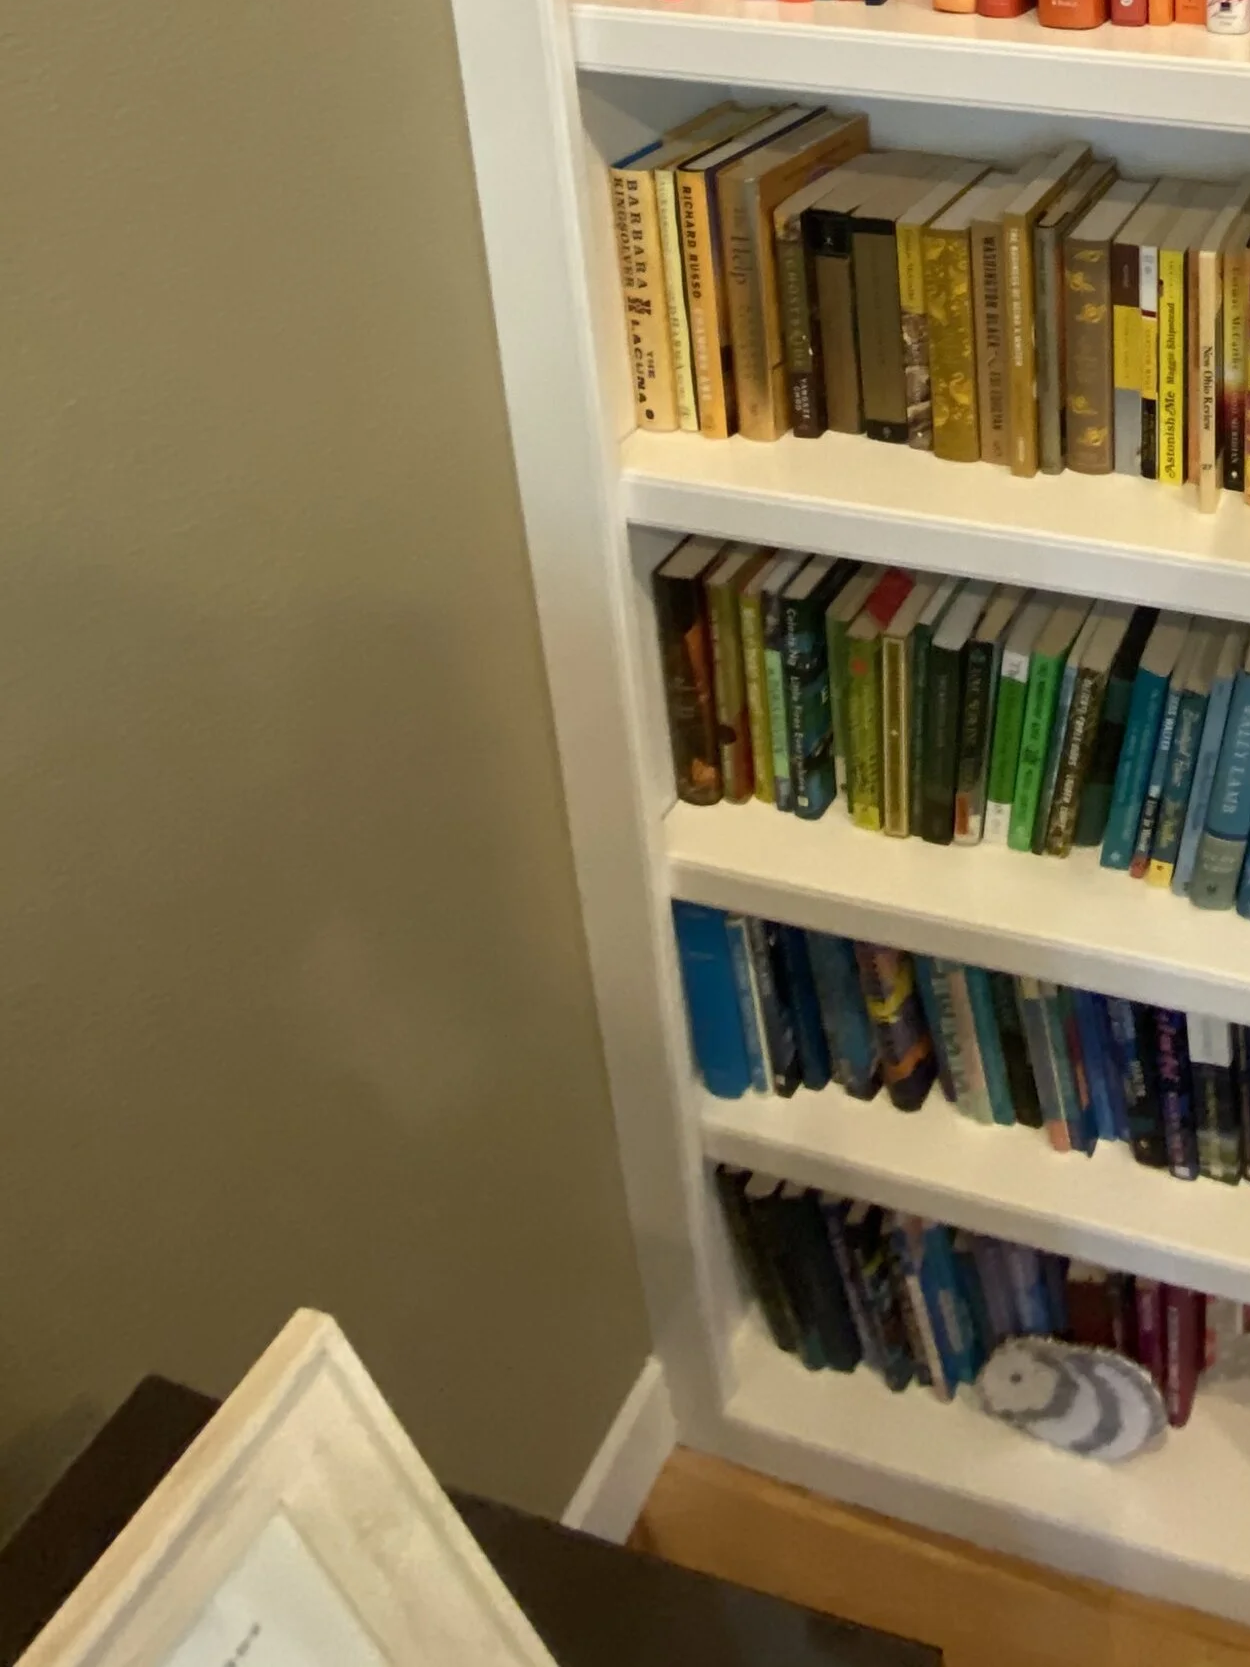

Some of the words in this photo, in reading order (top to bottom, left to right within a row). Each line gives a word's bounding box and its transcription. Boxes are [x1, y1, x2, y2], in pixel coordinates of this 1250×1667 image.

[613, 177, 636, 288] KINGSOLVER
[626, 178, 648, 290] BARBARA
[682, 185, 698, 249] RICHARD
[687, 252, 702, 300] RUSSO
[1166, 302, 1178, 350] Shipstead
[630, 319, 647, 404] LACUNA
[645, 350, 656, 380] THE
[1165, 350, 1177, 385] Maggie
[1202, 345, 1213, 367] New
[1163, 390, 1176, 417] Me
[1203, 367, 1213, 393] Ohio
[1203, 396, 1213, 431] Review
[1164, 417, 1177, 480] Astonish
[1229, 417, 1241, 464] MERIDIAN
[1160, 716, 1175, 751] WALTER
[1222, 765, 1246, 814] LAMB
